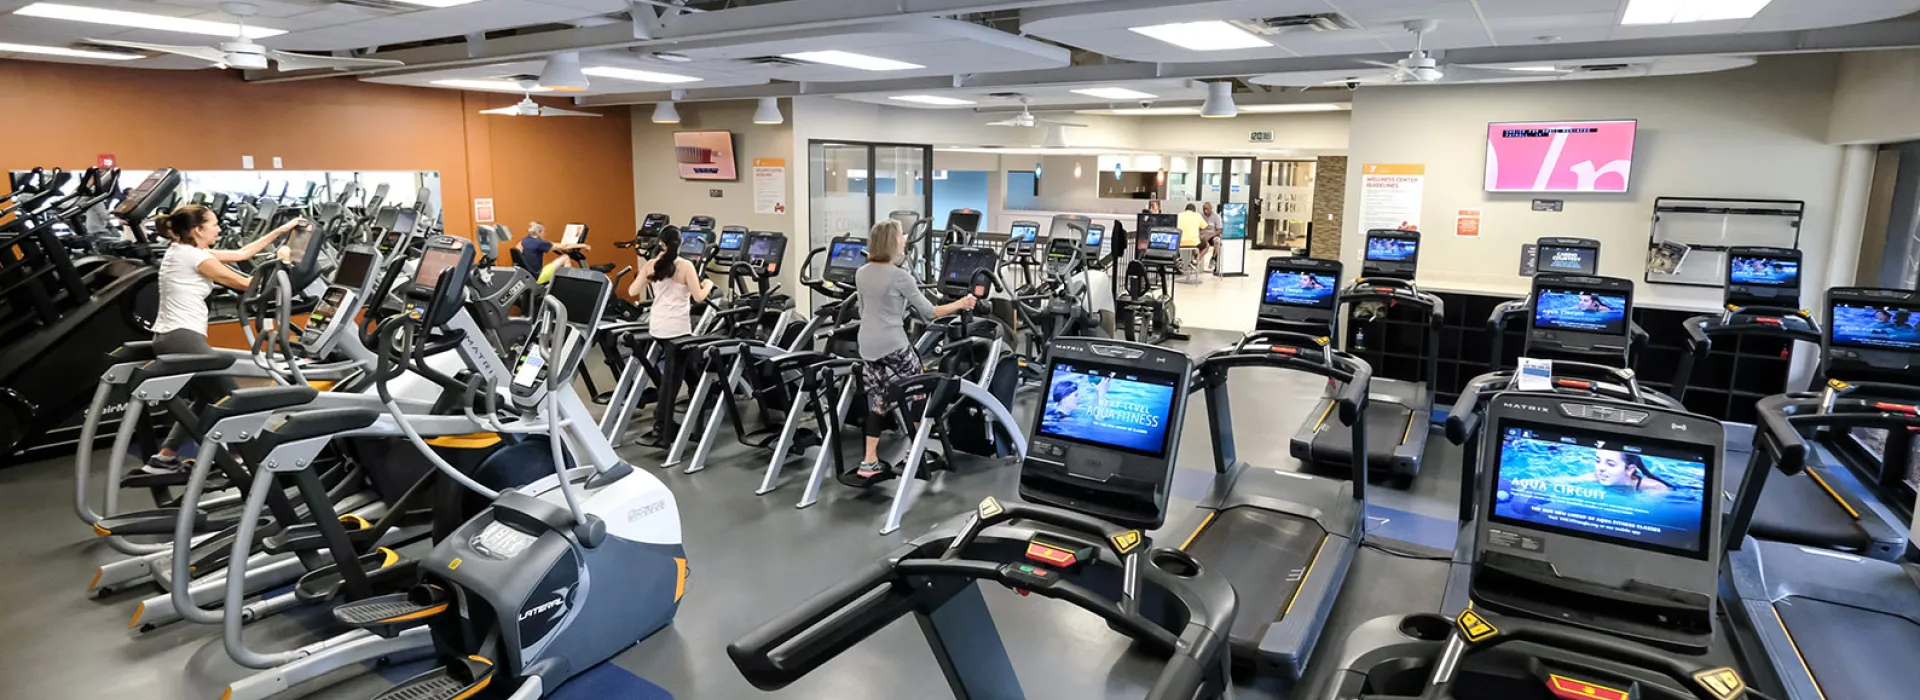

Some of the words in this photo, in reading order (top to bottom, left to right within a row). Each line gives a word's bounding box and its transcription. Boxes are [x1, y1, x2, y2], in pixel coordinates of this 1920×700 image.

[464, 333, 494, 375] MATRI
[1055, 343, 1084, 352] MATRIX
[84, 399, 160, 419] SairMer
[1086, 404, 1114, 420] AQUA
[1116, 409, 1159, 428] FITNESS
[1123, 401, 1150, 414] LEVEL
[1503, 402, 1549, 413] MATRIX
[1511, 477, 1547, 492] AQUA
[1554, 481, 1607, 500] CIRCUIT
[519, 597, 564, 621] LATERAL
